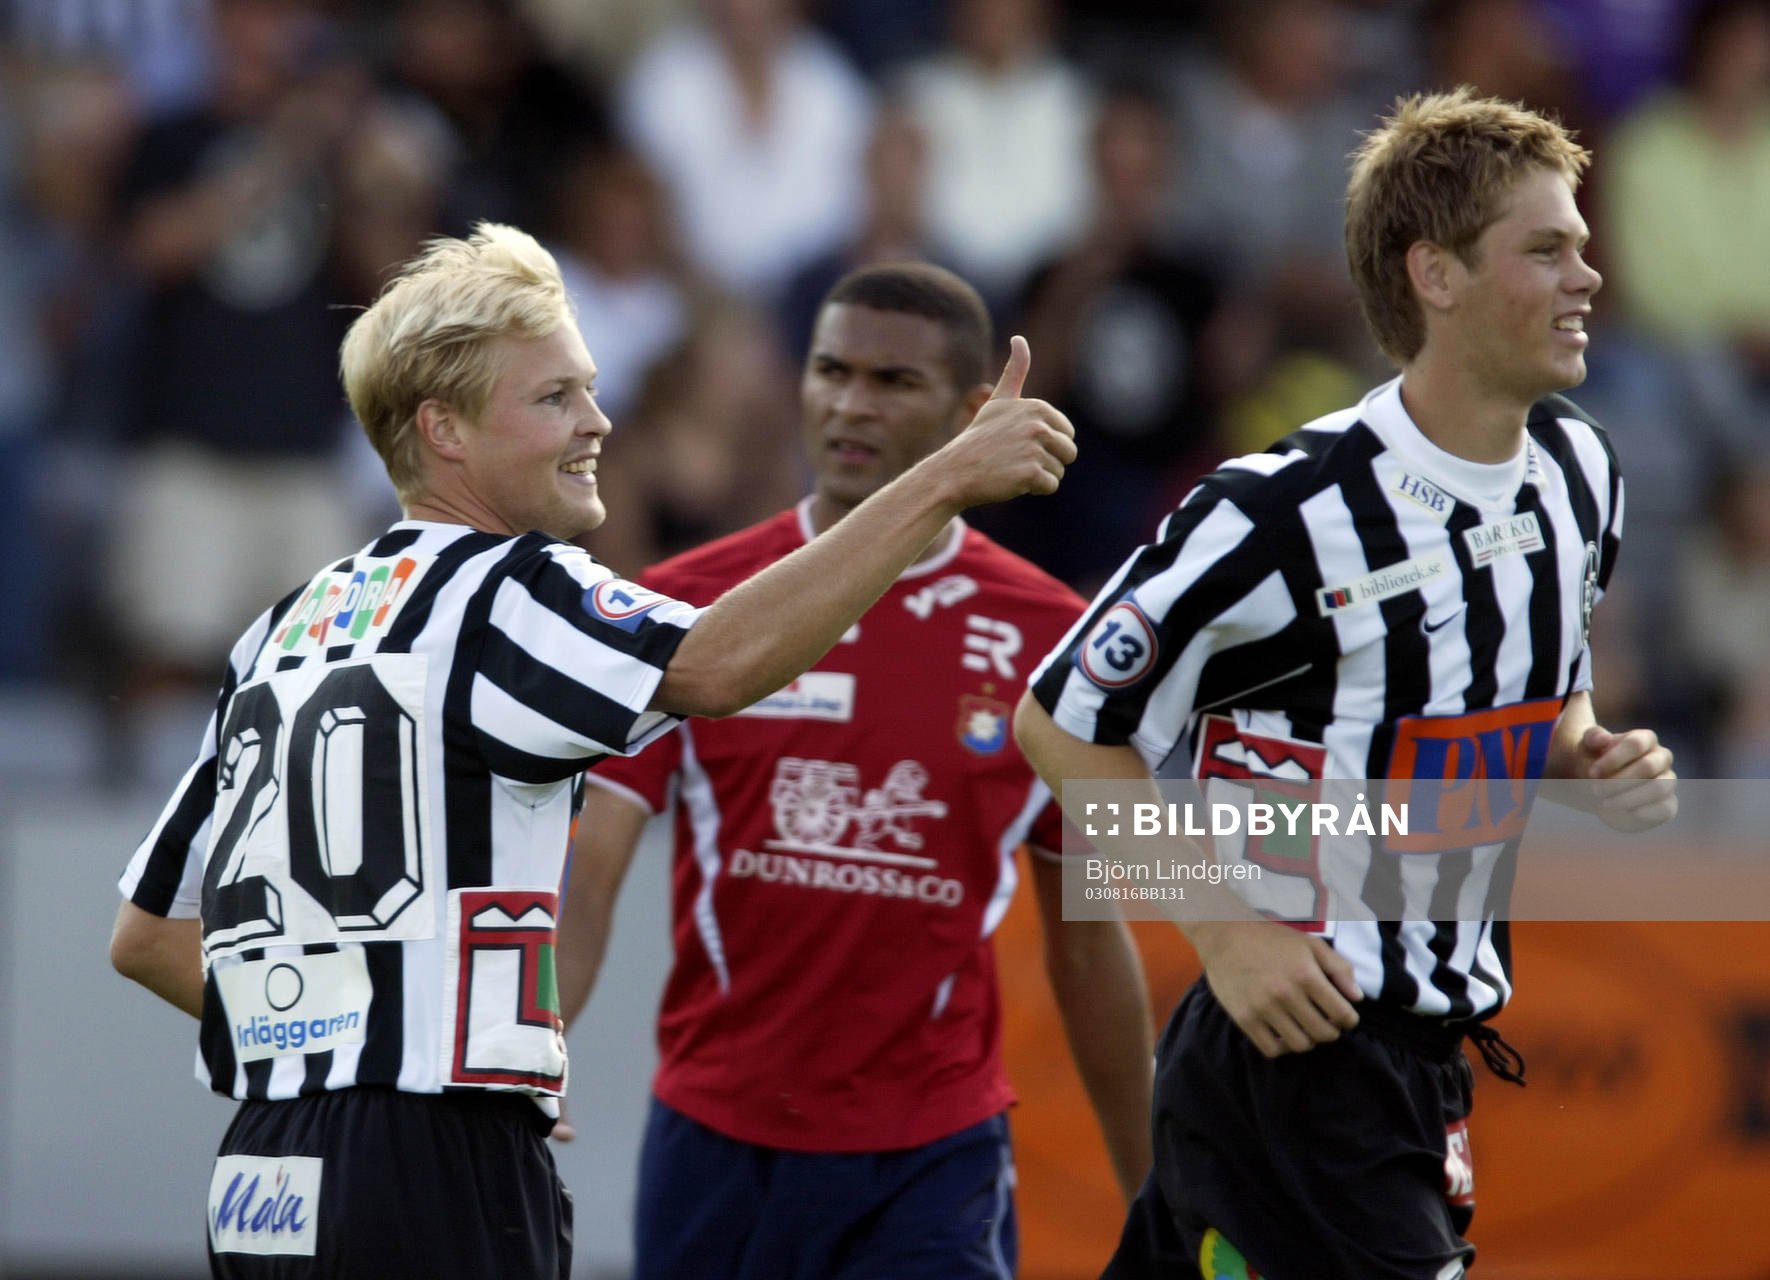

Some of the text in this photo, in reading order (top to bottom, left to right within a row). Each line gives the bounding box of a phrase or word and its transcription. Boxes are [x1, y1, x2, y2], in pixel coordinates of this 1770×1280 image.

[1399, 473, 1445, 512] HSB
[1360, 562, 1441, 599] bibliotek.se
[1093, 620, 1145, 671] 13
[200, 664, 424, 957] 20
[729, 848, 965, 907] DUNROSS&CO
